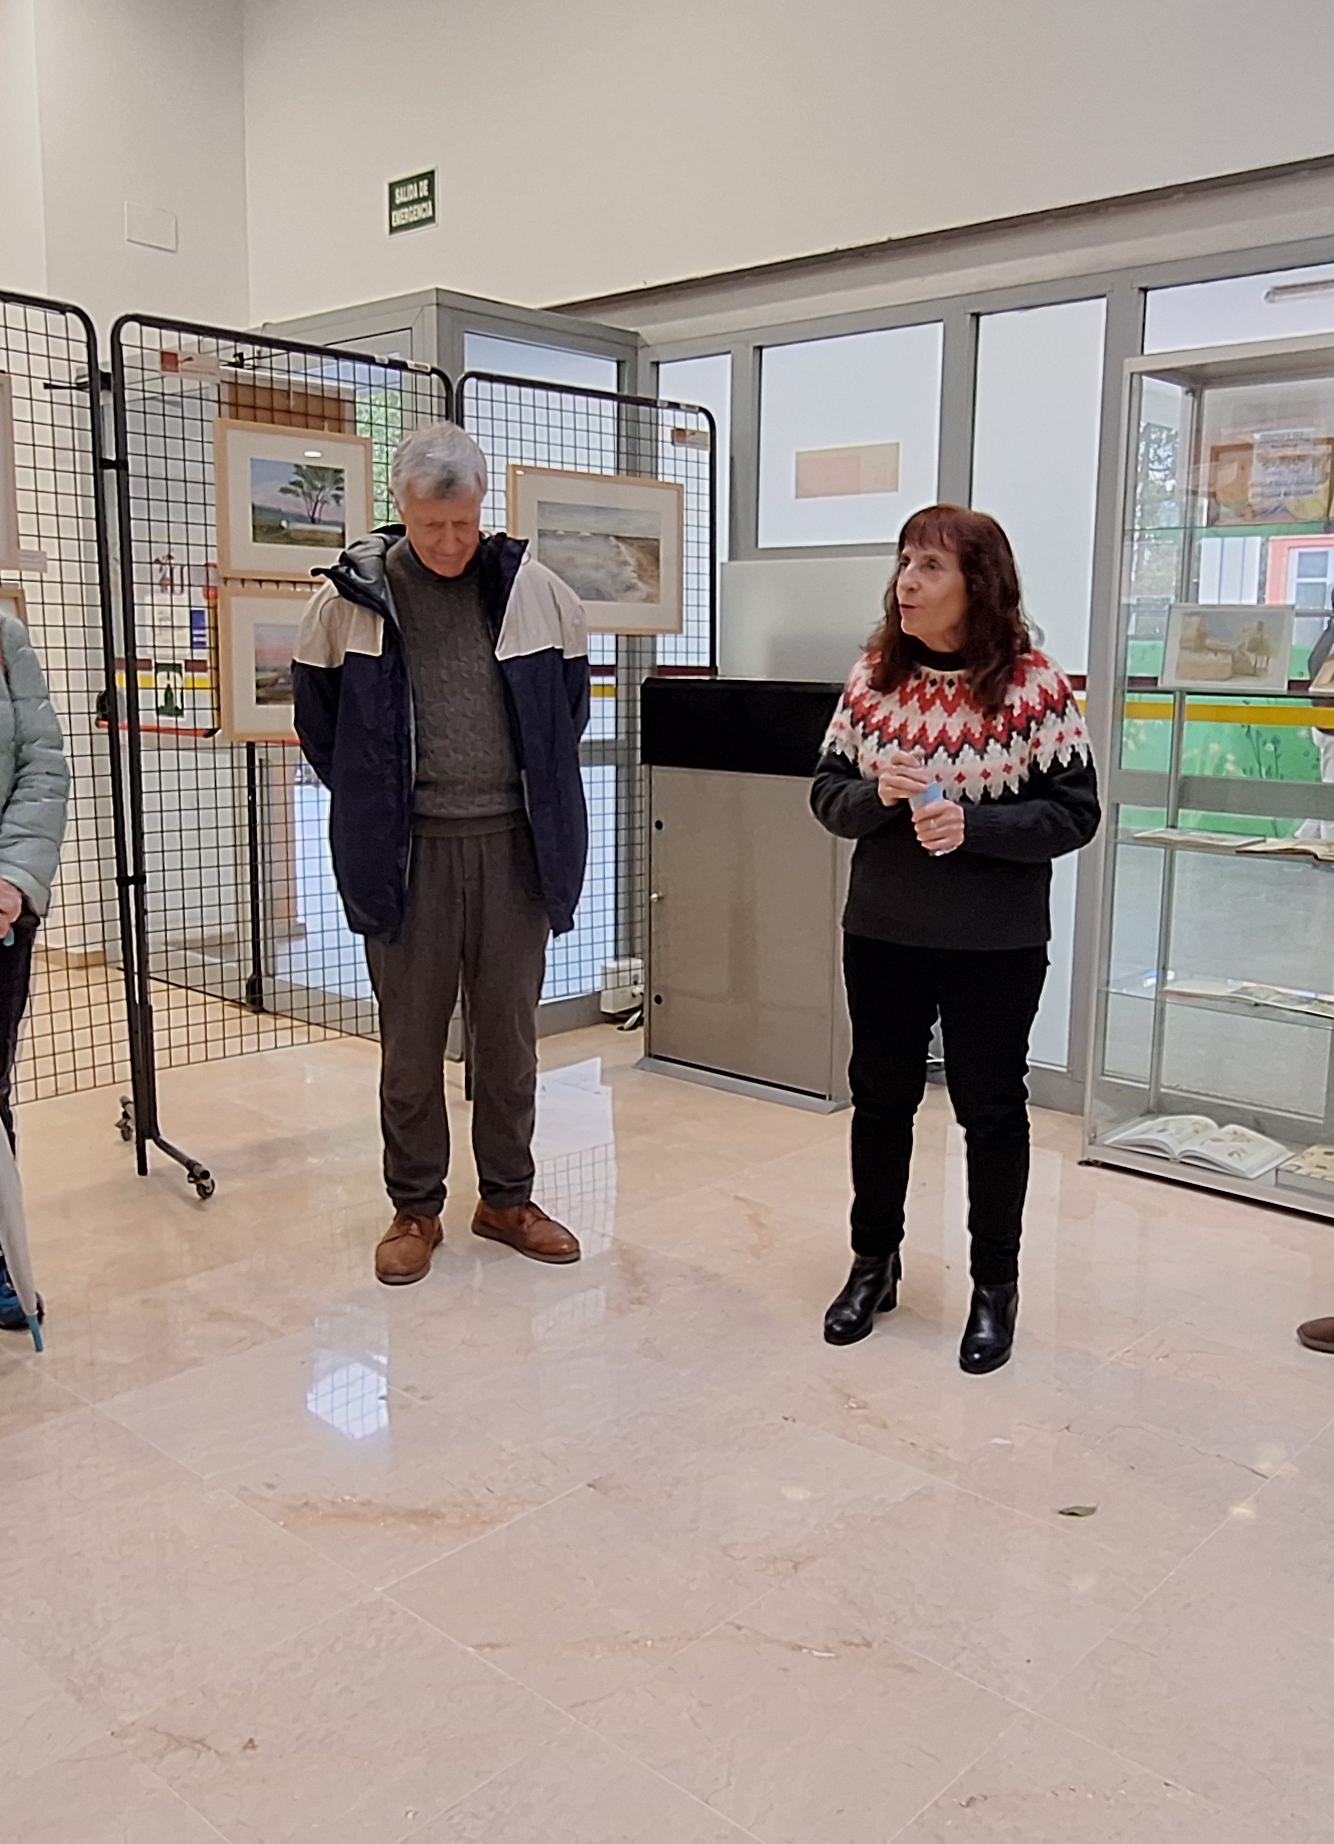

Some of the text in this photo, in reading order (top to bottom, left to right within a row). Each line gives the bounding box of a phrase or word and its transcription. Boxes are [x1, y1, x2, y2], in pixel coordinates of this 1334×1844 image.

[395, 179, 429, 205] SALIDA DE
[392, 200, 433, 227] EMERGENCIA
